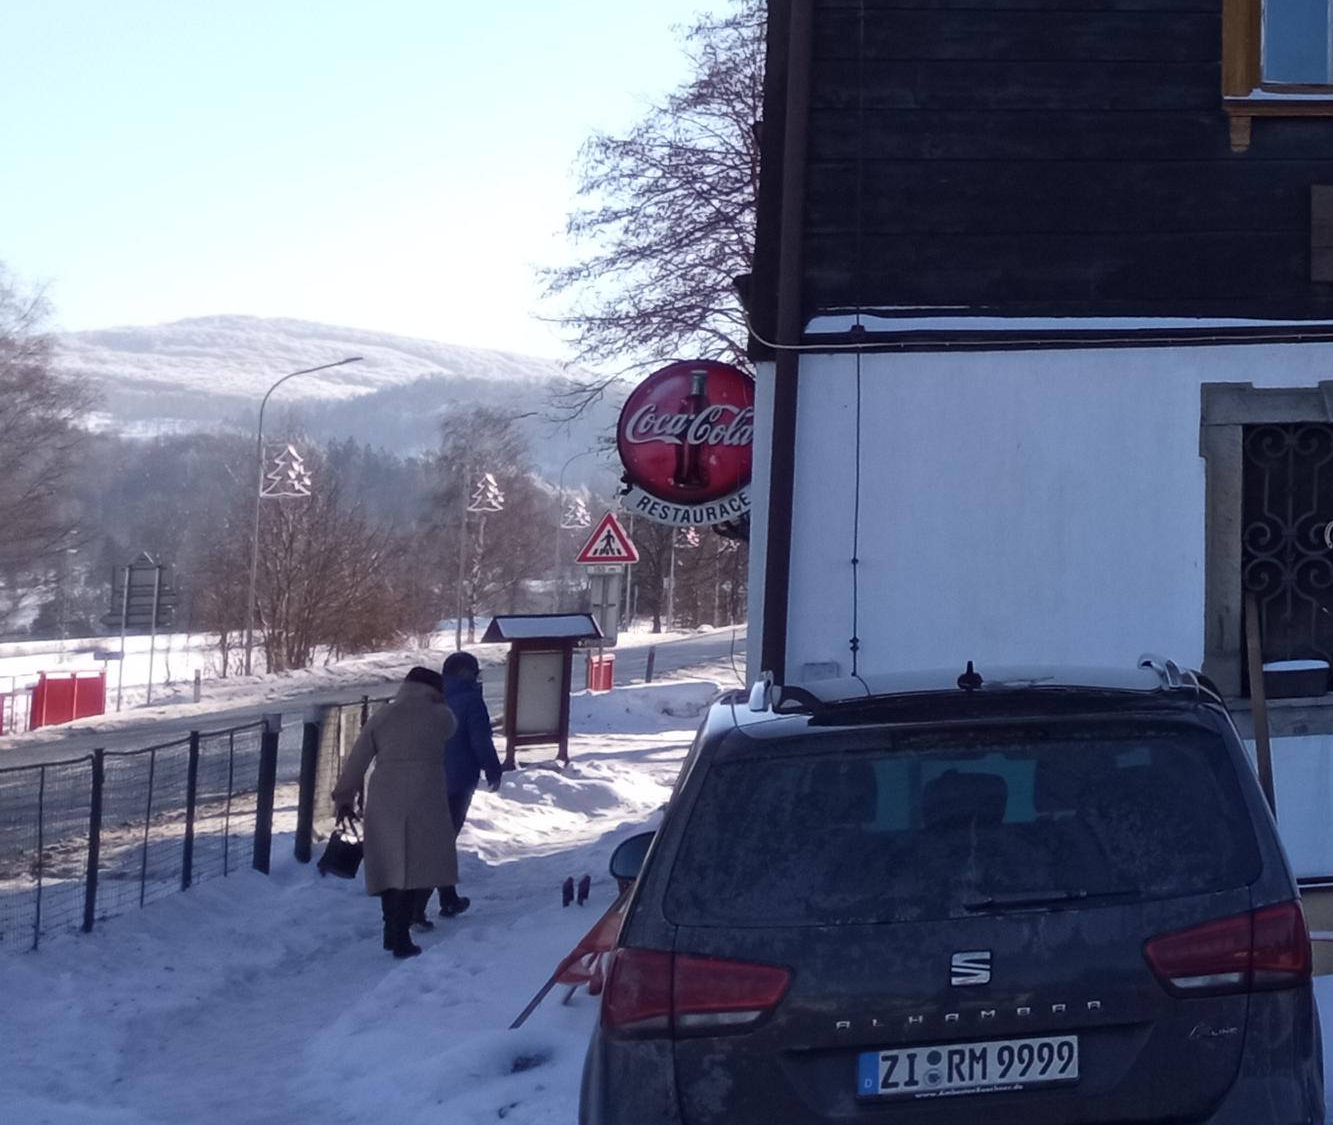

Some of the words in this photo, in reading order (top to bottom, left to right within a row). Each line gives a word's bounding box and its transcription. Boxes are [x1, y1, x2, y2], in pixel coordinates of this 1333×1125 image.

[636, 492, 752, 524] RESTAURACE
[880, 1053, 919, 1090] ZI
[946, 1046, 987, 1084] RM
[996, 1039, 1075, 1079] 9999
